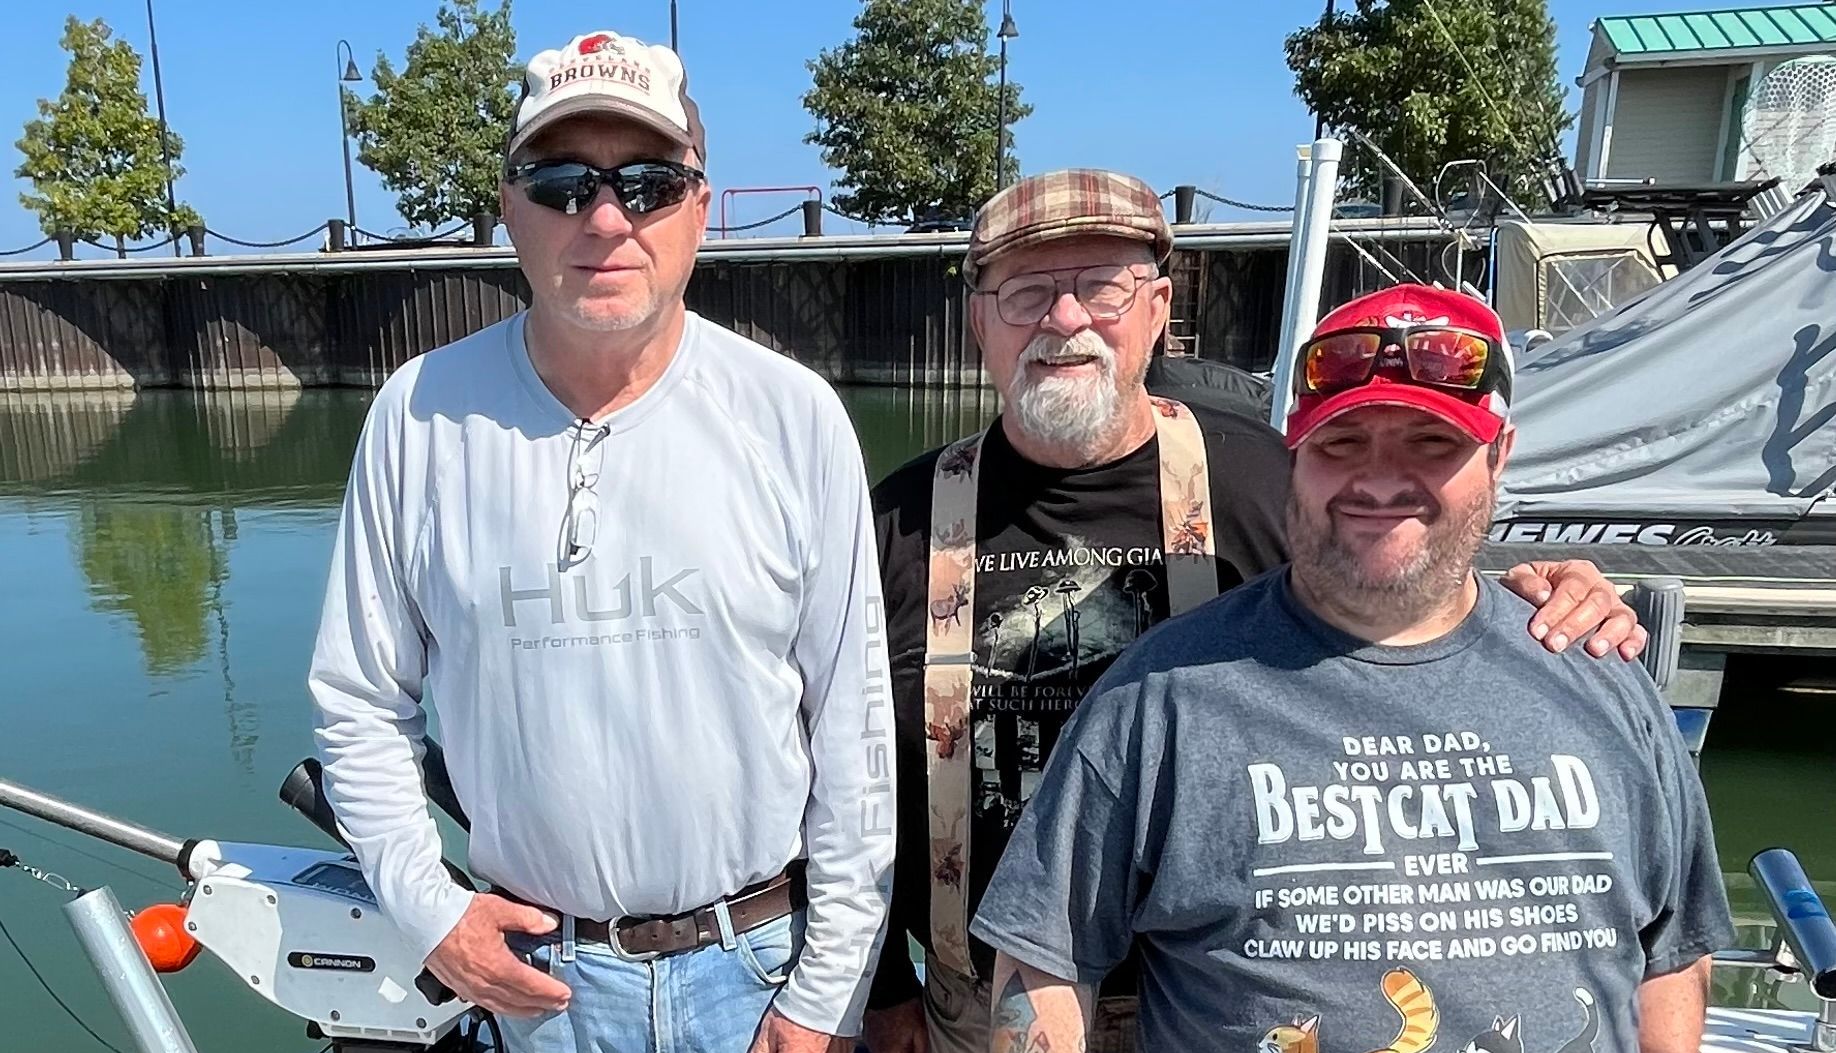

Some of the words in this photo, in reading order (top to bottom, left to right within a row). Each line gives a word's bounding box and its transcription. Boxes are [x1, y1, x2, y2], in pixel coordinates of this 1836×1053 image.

[550, 64, 651, 91] BROWNS
[1000, 551, 1040, 571] LIVE
[1041, 547, 1122, 568] AMONG
[1126, 547, 1165, 567] GIA
[511, 632, 633, 650] Performance
[635, 627, 701, 643] Fishing
[1011, 685, 1028, 698] BE
[1035, 685, 1090, 698] FOREV
[861, 595, 892, 838] Fishing
[989, 699, 1033, 711] SUCH
[1342, 735, 1414, 757] DEAR
[1422, 731, 1491, 756] DAD,
[1333, 760, 1390, 782] YOU
[1400, 758, 1452, 781] ARE
[1459, 754, 1513, 777] THE
[1490, 753, 1601, 833] DAD
[1404, 852, 1469, 876] EVER
[1254, 889, 1274, 909] IF
[1277, 886, 1339, 908] SOME
[1342, 884, 1415, 906] OTHER
[1418, 882, 1472, 904] MAN
[1474, 878, 1526, 901] WAS
[1529, 875, 1570, 897] OUR
[1571, 874, 1613, 895] DAD
[1295, 913, 1356, 934] WE'D
[1363, 911, 1414, 933] PISS
[1419, 910, 1457, 932] ON
[1463, 907, 1503, 930] HIS
[1509, 903, 1579, 927] SHOES
[1244, 939, 1303, 960] CLAW
[1308, 940, 1339, 960] UP
[1343, 939, 1382, 961] HIS
[1386, 938, 1443, 961] FACE
[1447, 936, 1497, 959] AND
[1500, 934, 1538, 955] GO
[1540, 930, 1583, 953] FIND
[1584, 928, 1618, 949] YOU
[313, 957, 362, 969] CANNON
